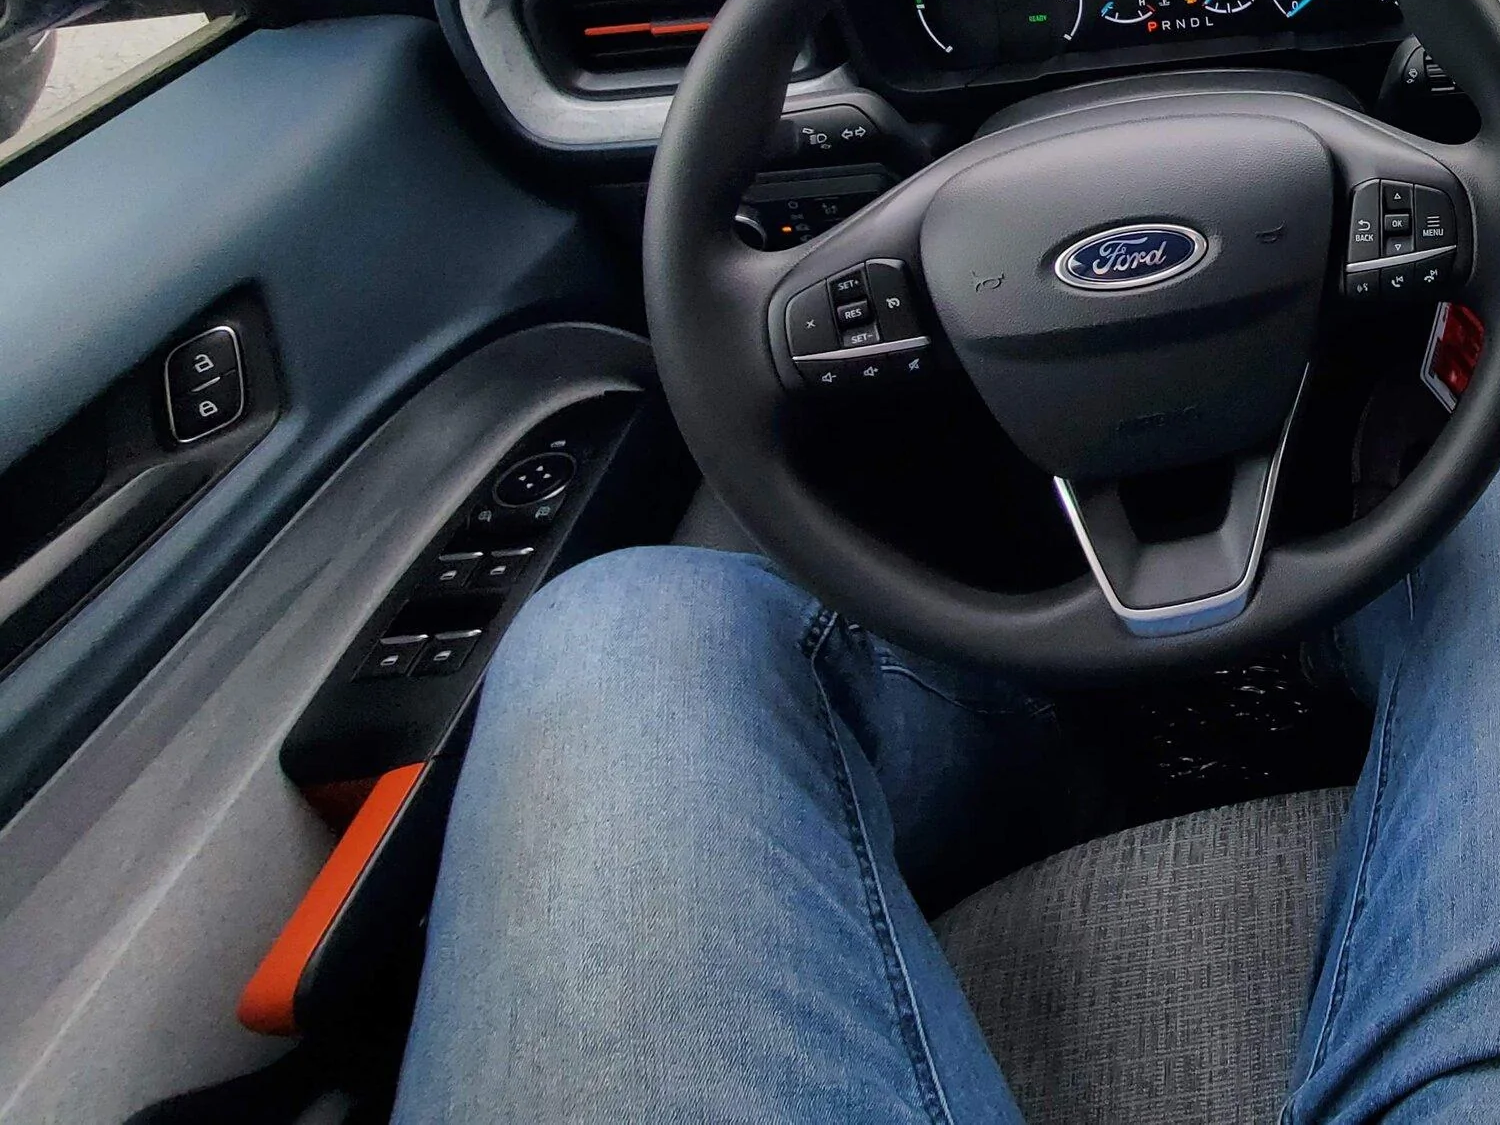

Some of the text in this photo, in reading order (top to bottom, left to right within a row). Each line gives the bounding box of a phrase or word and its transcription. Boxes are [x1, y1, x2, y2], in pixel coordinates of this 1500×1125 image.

[1391, 220, 1402, 228] OK
[1422, 229, 1444, 237] MENU
[1355, 234, 1374, 242] BACK
[1092, 236, 1168, 275] Ford
[844, 308, 862, 319] RES
